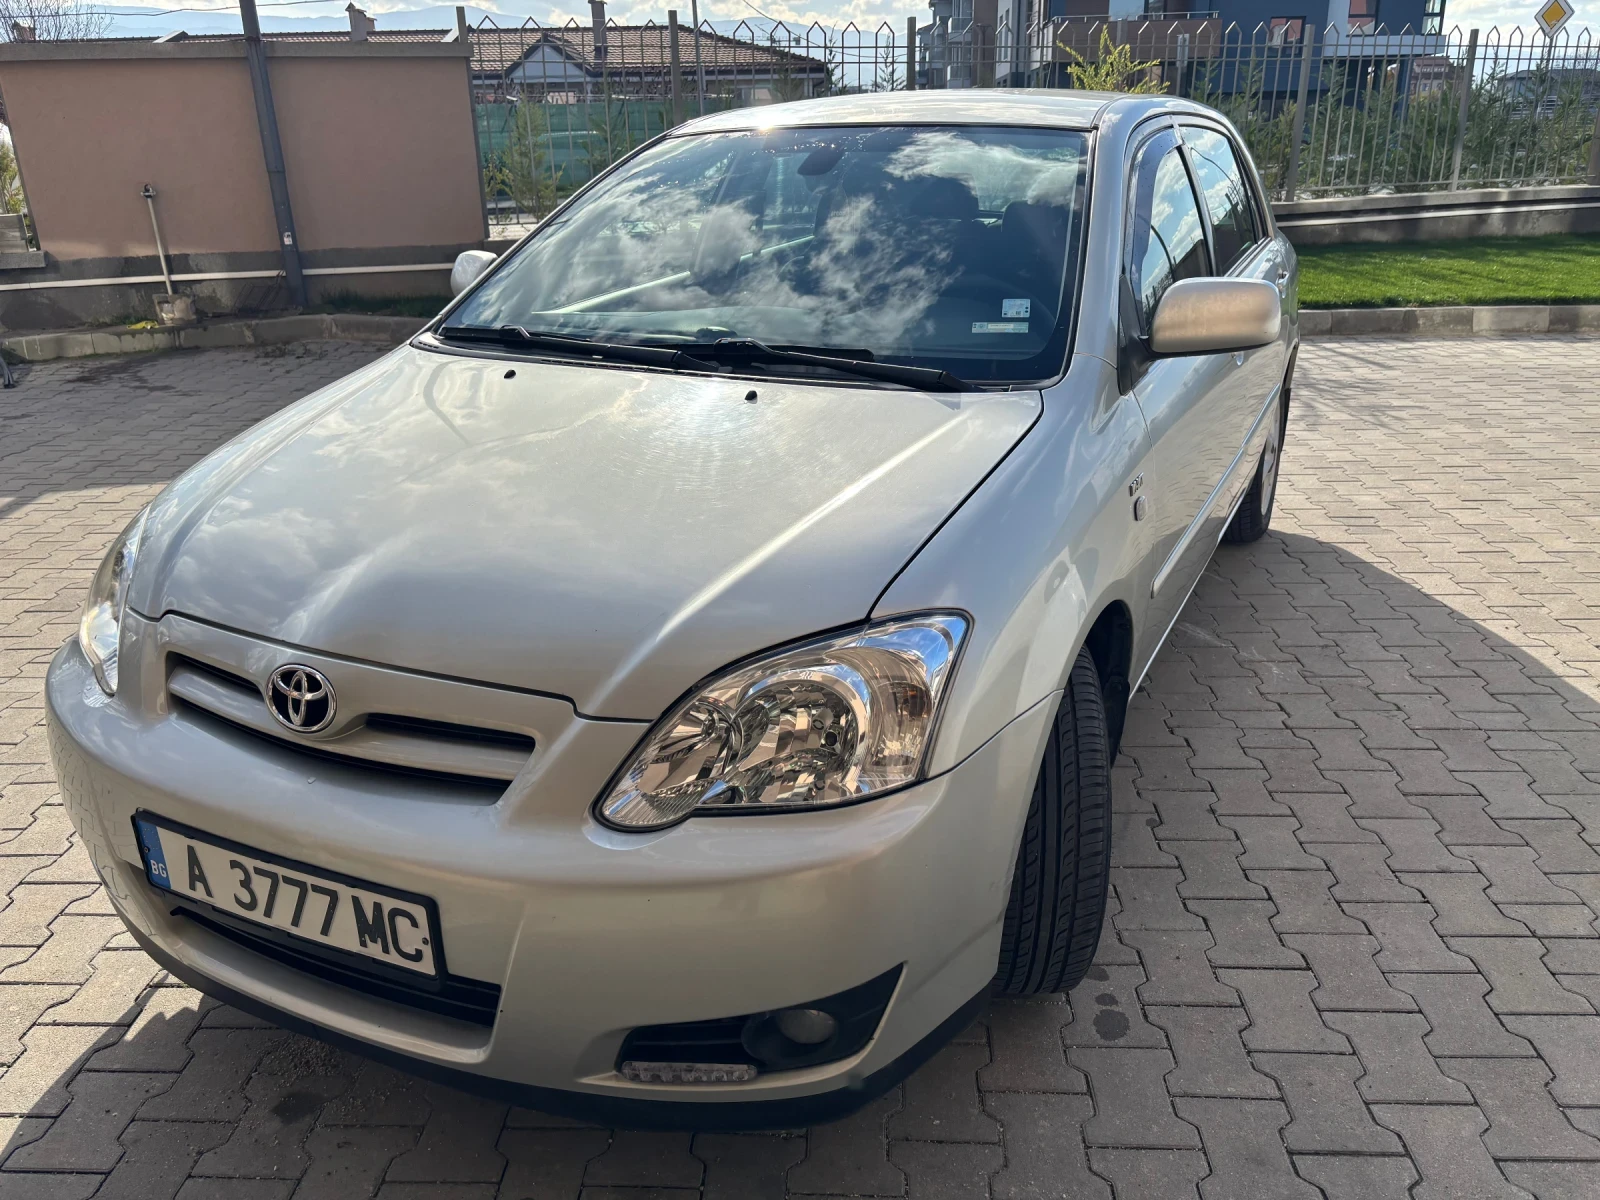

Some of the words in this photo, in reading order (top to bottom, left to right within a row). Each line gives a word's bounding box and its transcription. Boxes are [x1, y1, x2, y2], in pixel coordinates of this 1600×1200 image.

[150, 859, 168, 878] BG
[187, 844, 214, 898] A
[229, 859, 339, 937] 3777
[351, 894, 424, 963] MC
